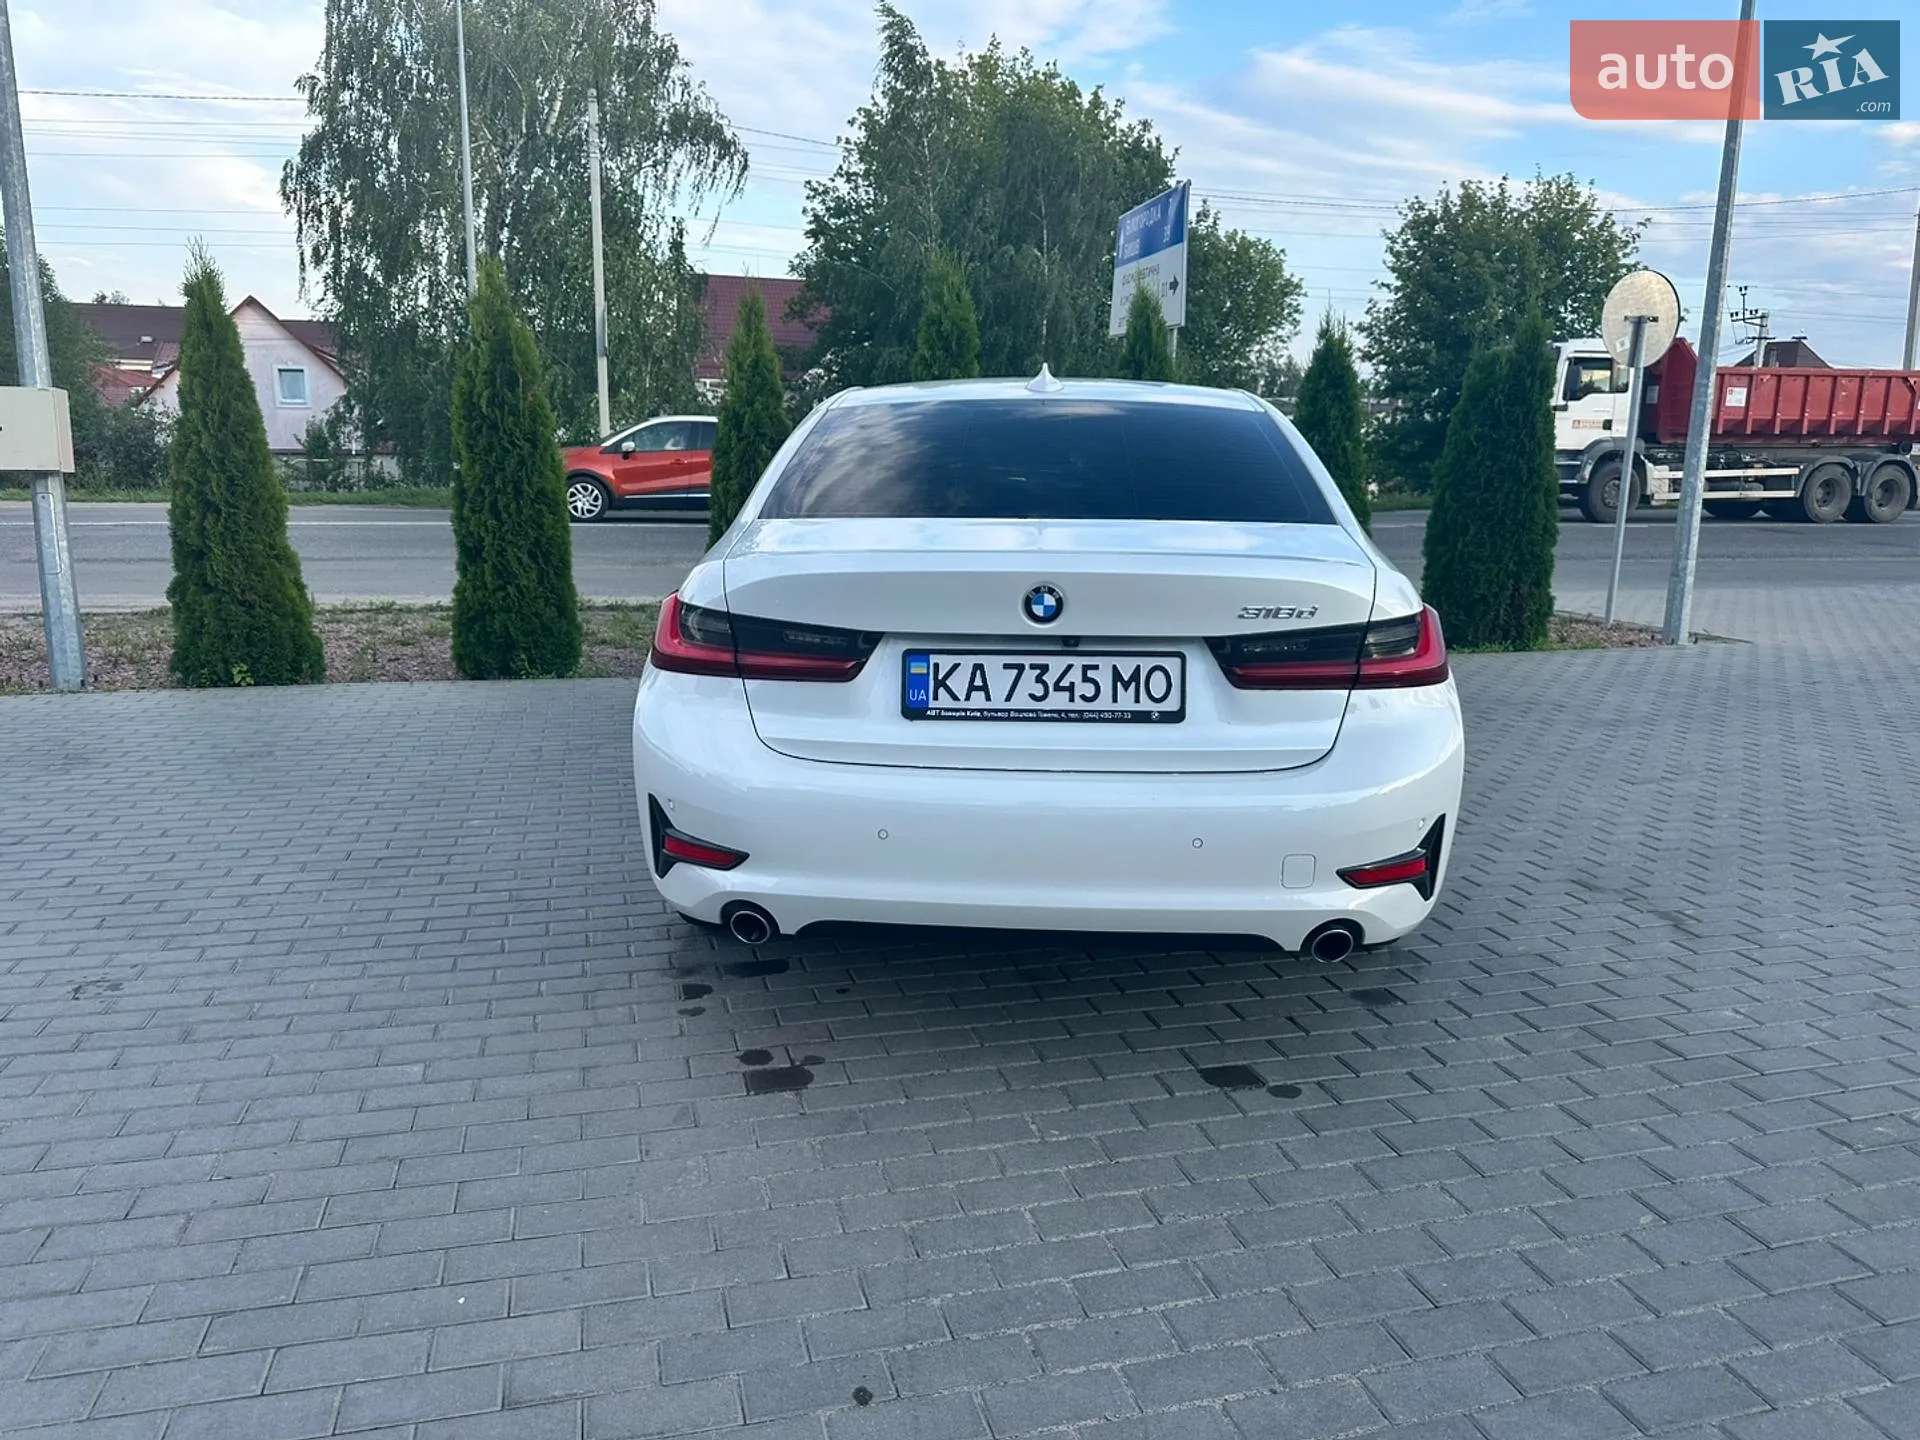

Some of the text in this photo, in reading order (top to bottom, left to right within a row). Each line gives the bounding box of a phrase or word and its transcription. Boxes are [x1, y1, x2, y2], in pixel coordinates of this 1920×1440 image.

[1237, 604, 1319, 621] 318d
[932, 662, 1174, 704] KA 7345 MO
[909, 688, 927, 701] UA
